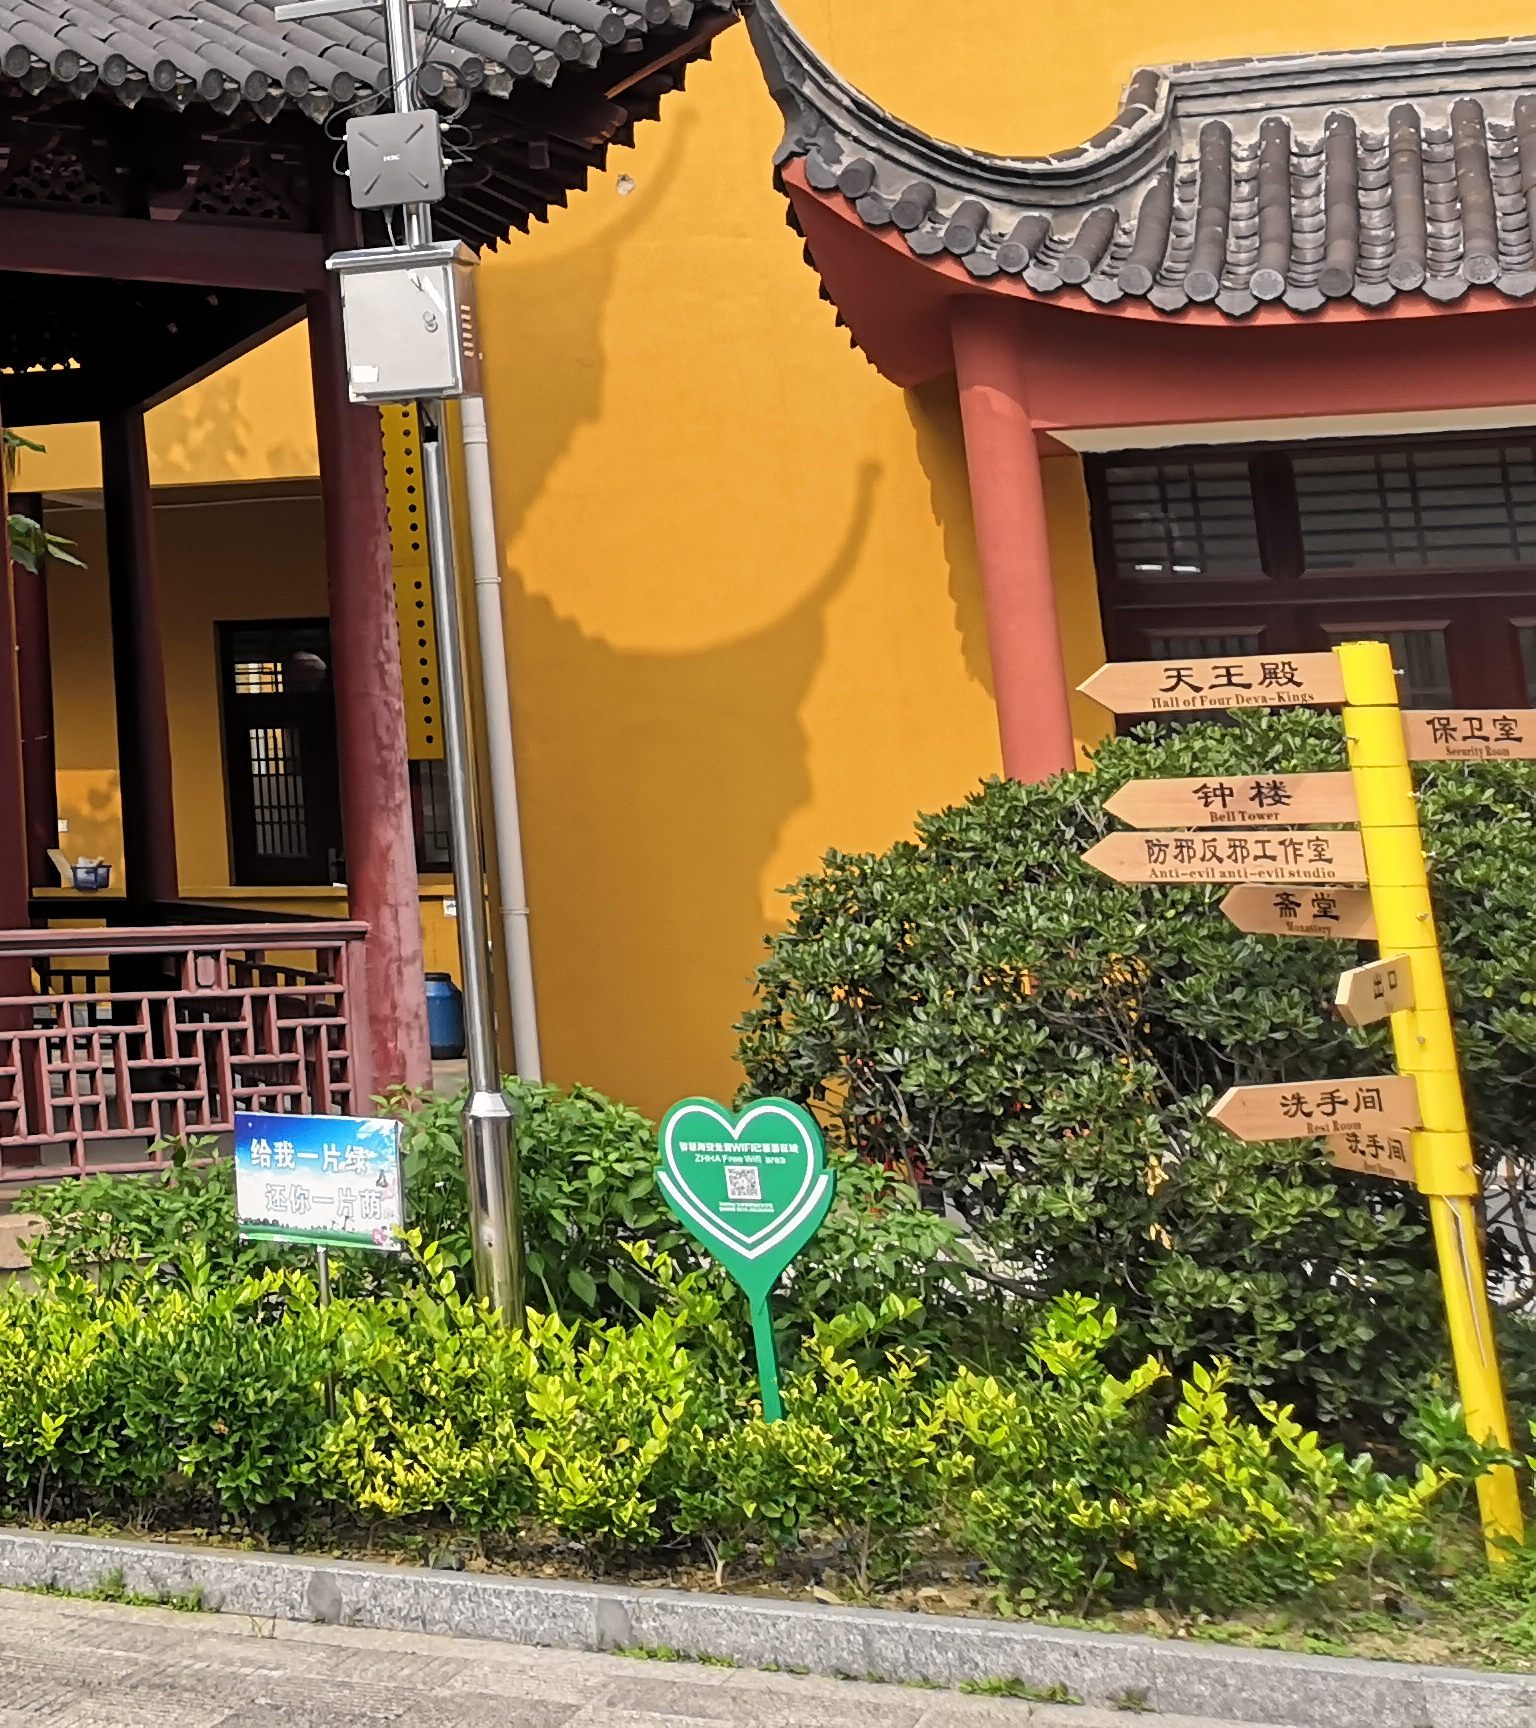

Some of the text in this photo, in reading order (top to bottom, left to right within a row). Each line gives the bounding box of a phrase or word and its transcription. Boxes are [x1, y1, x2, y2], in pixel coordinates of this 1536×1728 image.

[1158, 661, 1304, 693] 天王殿
[1151, 692, 1315, 709] Hall of Four Deva-Kings
[1425, 715, 1524, 744] 保卫室
[1192, 779, 1293, 809] 钟楼
[1209, 811, 1280, 823] Bell Tower
[1144, 835, 1333, 865] 防邪反邪工作室
[1148, 867, 1336, 879] Anti-evil anti-evil studio
[1273, 891, 1340, 921] 斋堂
[1373, 970, 1398, 1000] 出口
[1280, 1086, 1385, 1119] 洗手间
[1306, 1121, 1331, 1133] Rest
[250, 1138, 369, 1172] 给我一片绿
[1345, 1131, 1407, 1164] 洗手间
[265, 1183, 383, 1219] 还你一片荫
